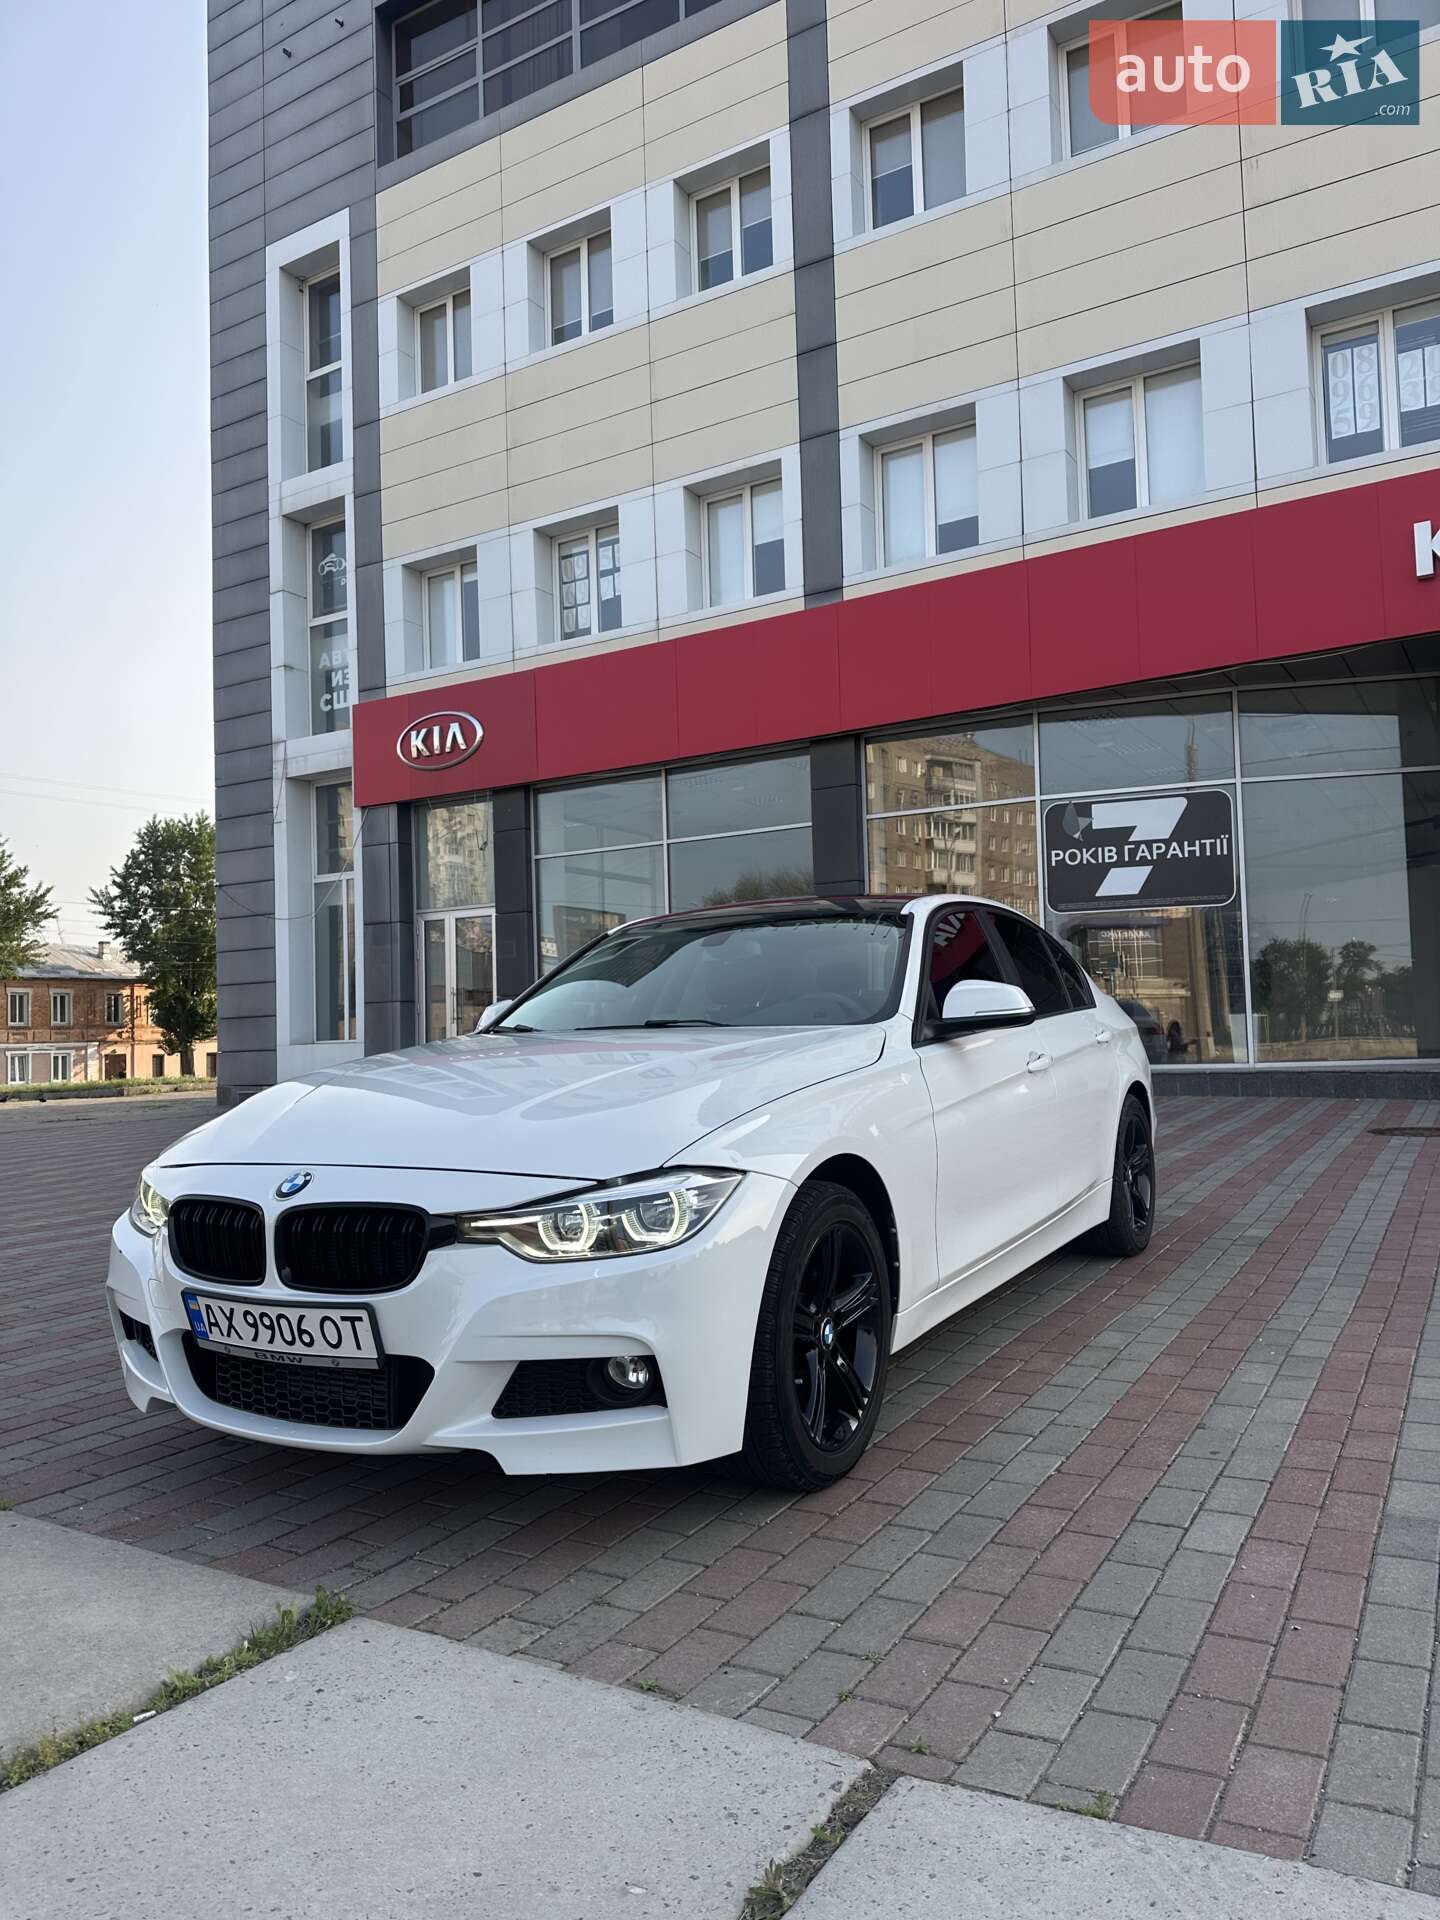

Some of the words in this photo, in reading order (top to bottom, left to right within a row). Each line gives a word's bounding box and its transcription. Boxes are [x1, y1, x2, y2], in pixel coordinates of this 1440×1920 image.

[410, 722, 467, 758] KIA
[1051, 846, 1117, 867] РОКІВ
[1124, 835, 1229, 862] ГАРАНТІЇ
[1091, 797, 1187, 896] 7
[243, 1310, 314, 1348] 9906
[254, 1352, 303, 1363] BMW
